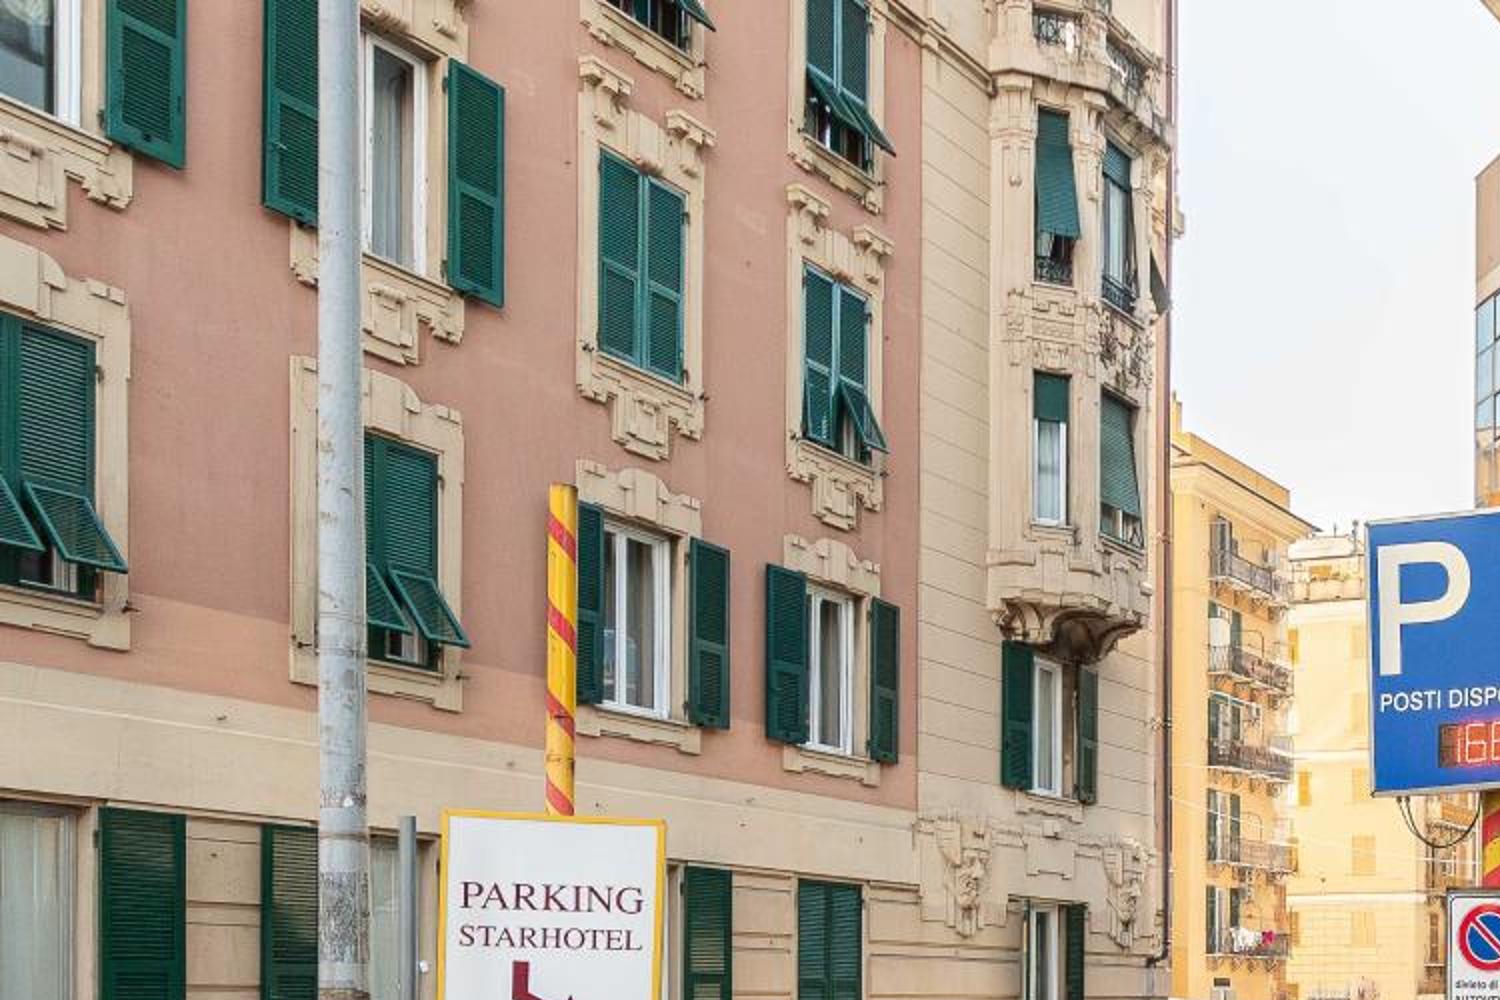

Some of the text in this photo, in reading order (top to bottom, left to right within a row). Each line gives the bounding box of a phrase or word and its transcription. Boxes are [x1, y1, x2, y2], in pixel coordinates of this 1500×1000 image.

[1377, 541, 1471, 676] P
[1380, 690, 1442, 713] POSTI
[460, 881, 645, 914] PARKING
[459, 925, 643, 951] STARHOTEL
[1455, 979, 1486, 990] divieto
[1488, 979, 1498, 990] di
